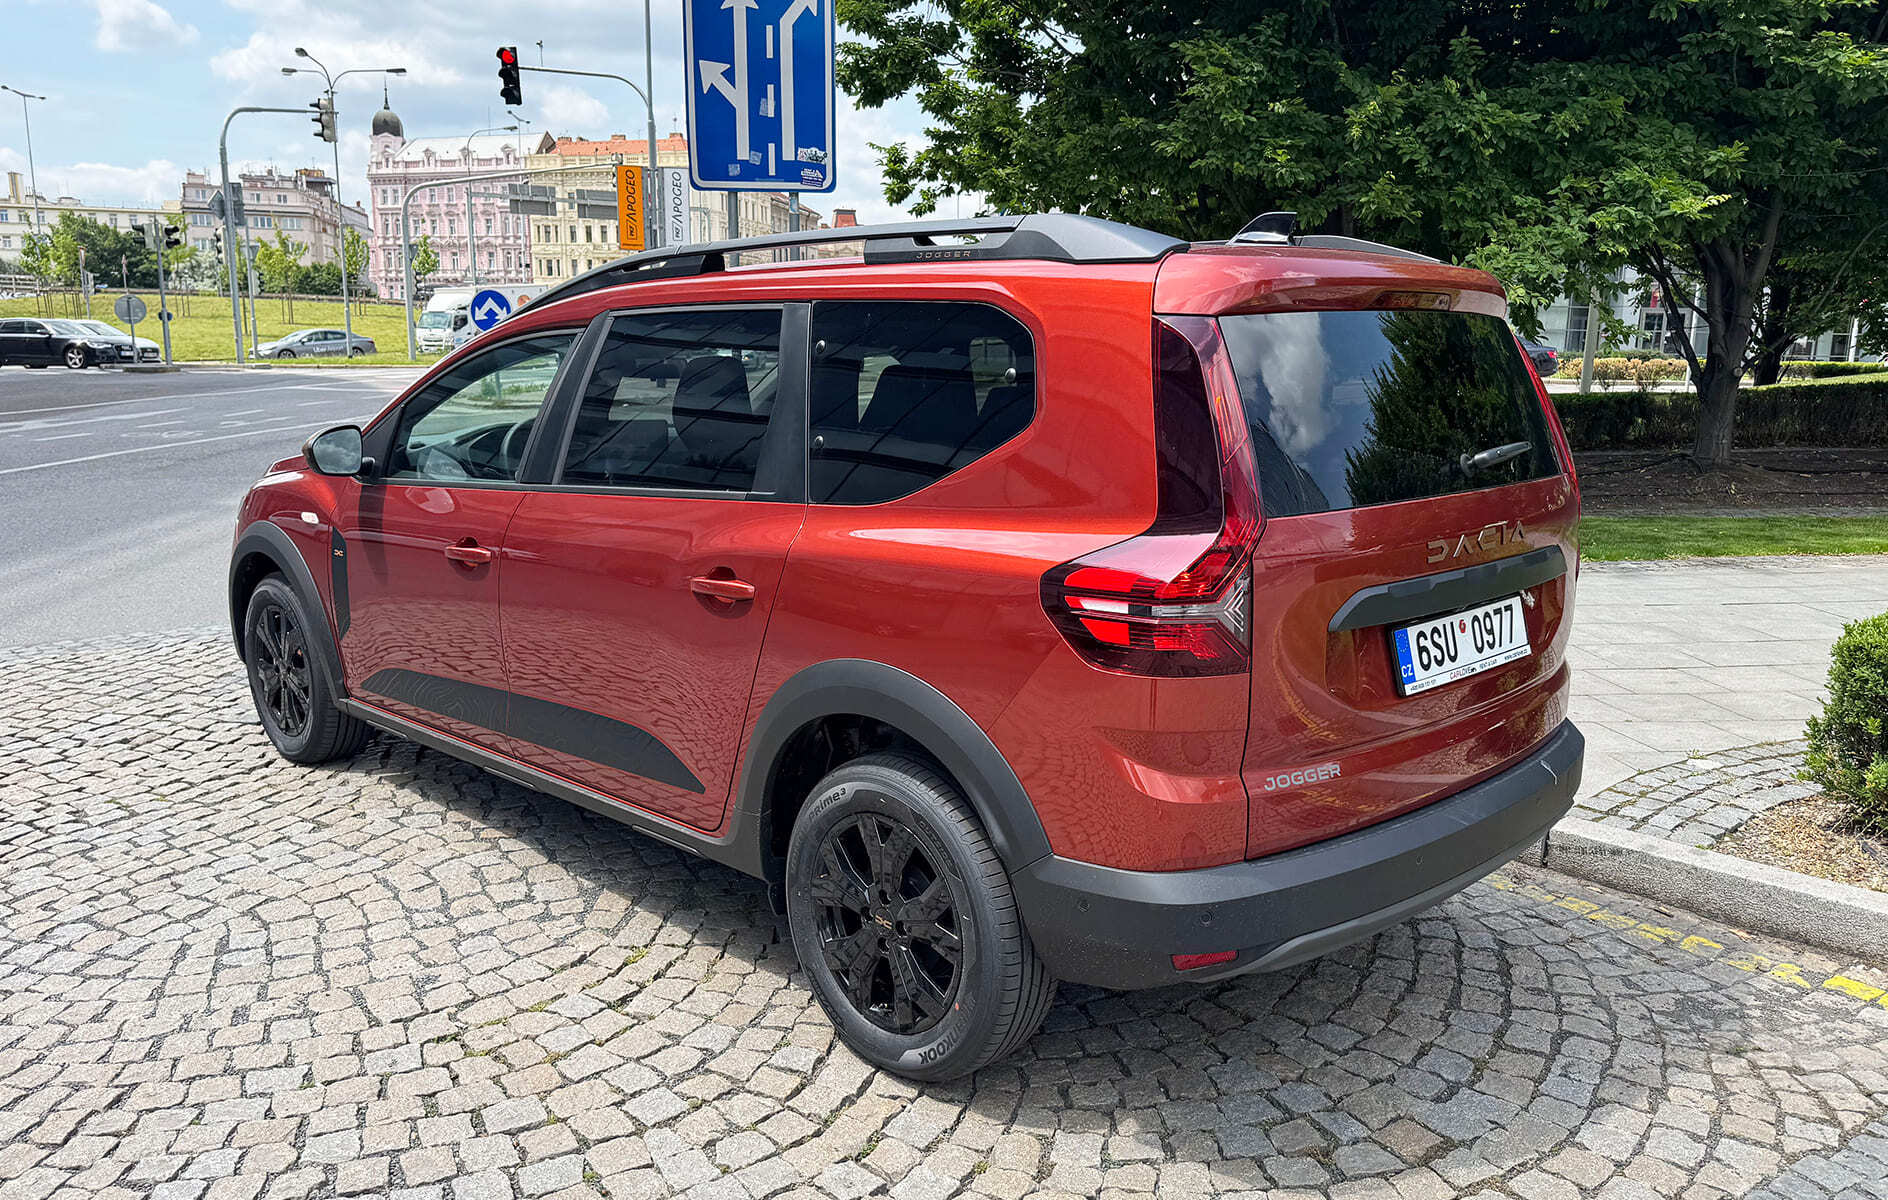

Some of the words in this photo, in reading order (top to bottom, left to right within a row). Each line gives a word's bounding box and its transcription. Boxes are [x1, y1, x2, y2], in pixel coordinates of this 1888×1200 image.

[625, 169, 637, 222] APOGEO
[672, 171, 683, 224] APOGEO
[916, 251, 971, 259] JOGGER
[1427, 520, 1525, 564] DACIA
[1416, 622, 1458, 671] 6SU
[1471, 604, 1513, 654] 0977
[1401, 664, 1413, 678] CZ
[1264, 764, 1341, 791] JOGGER
